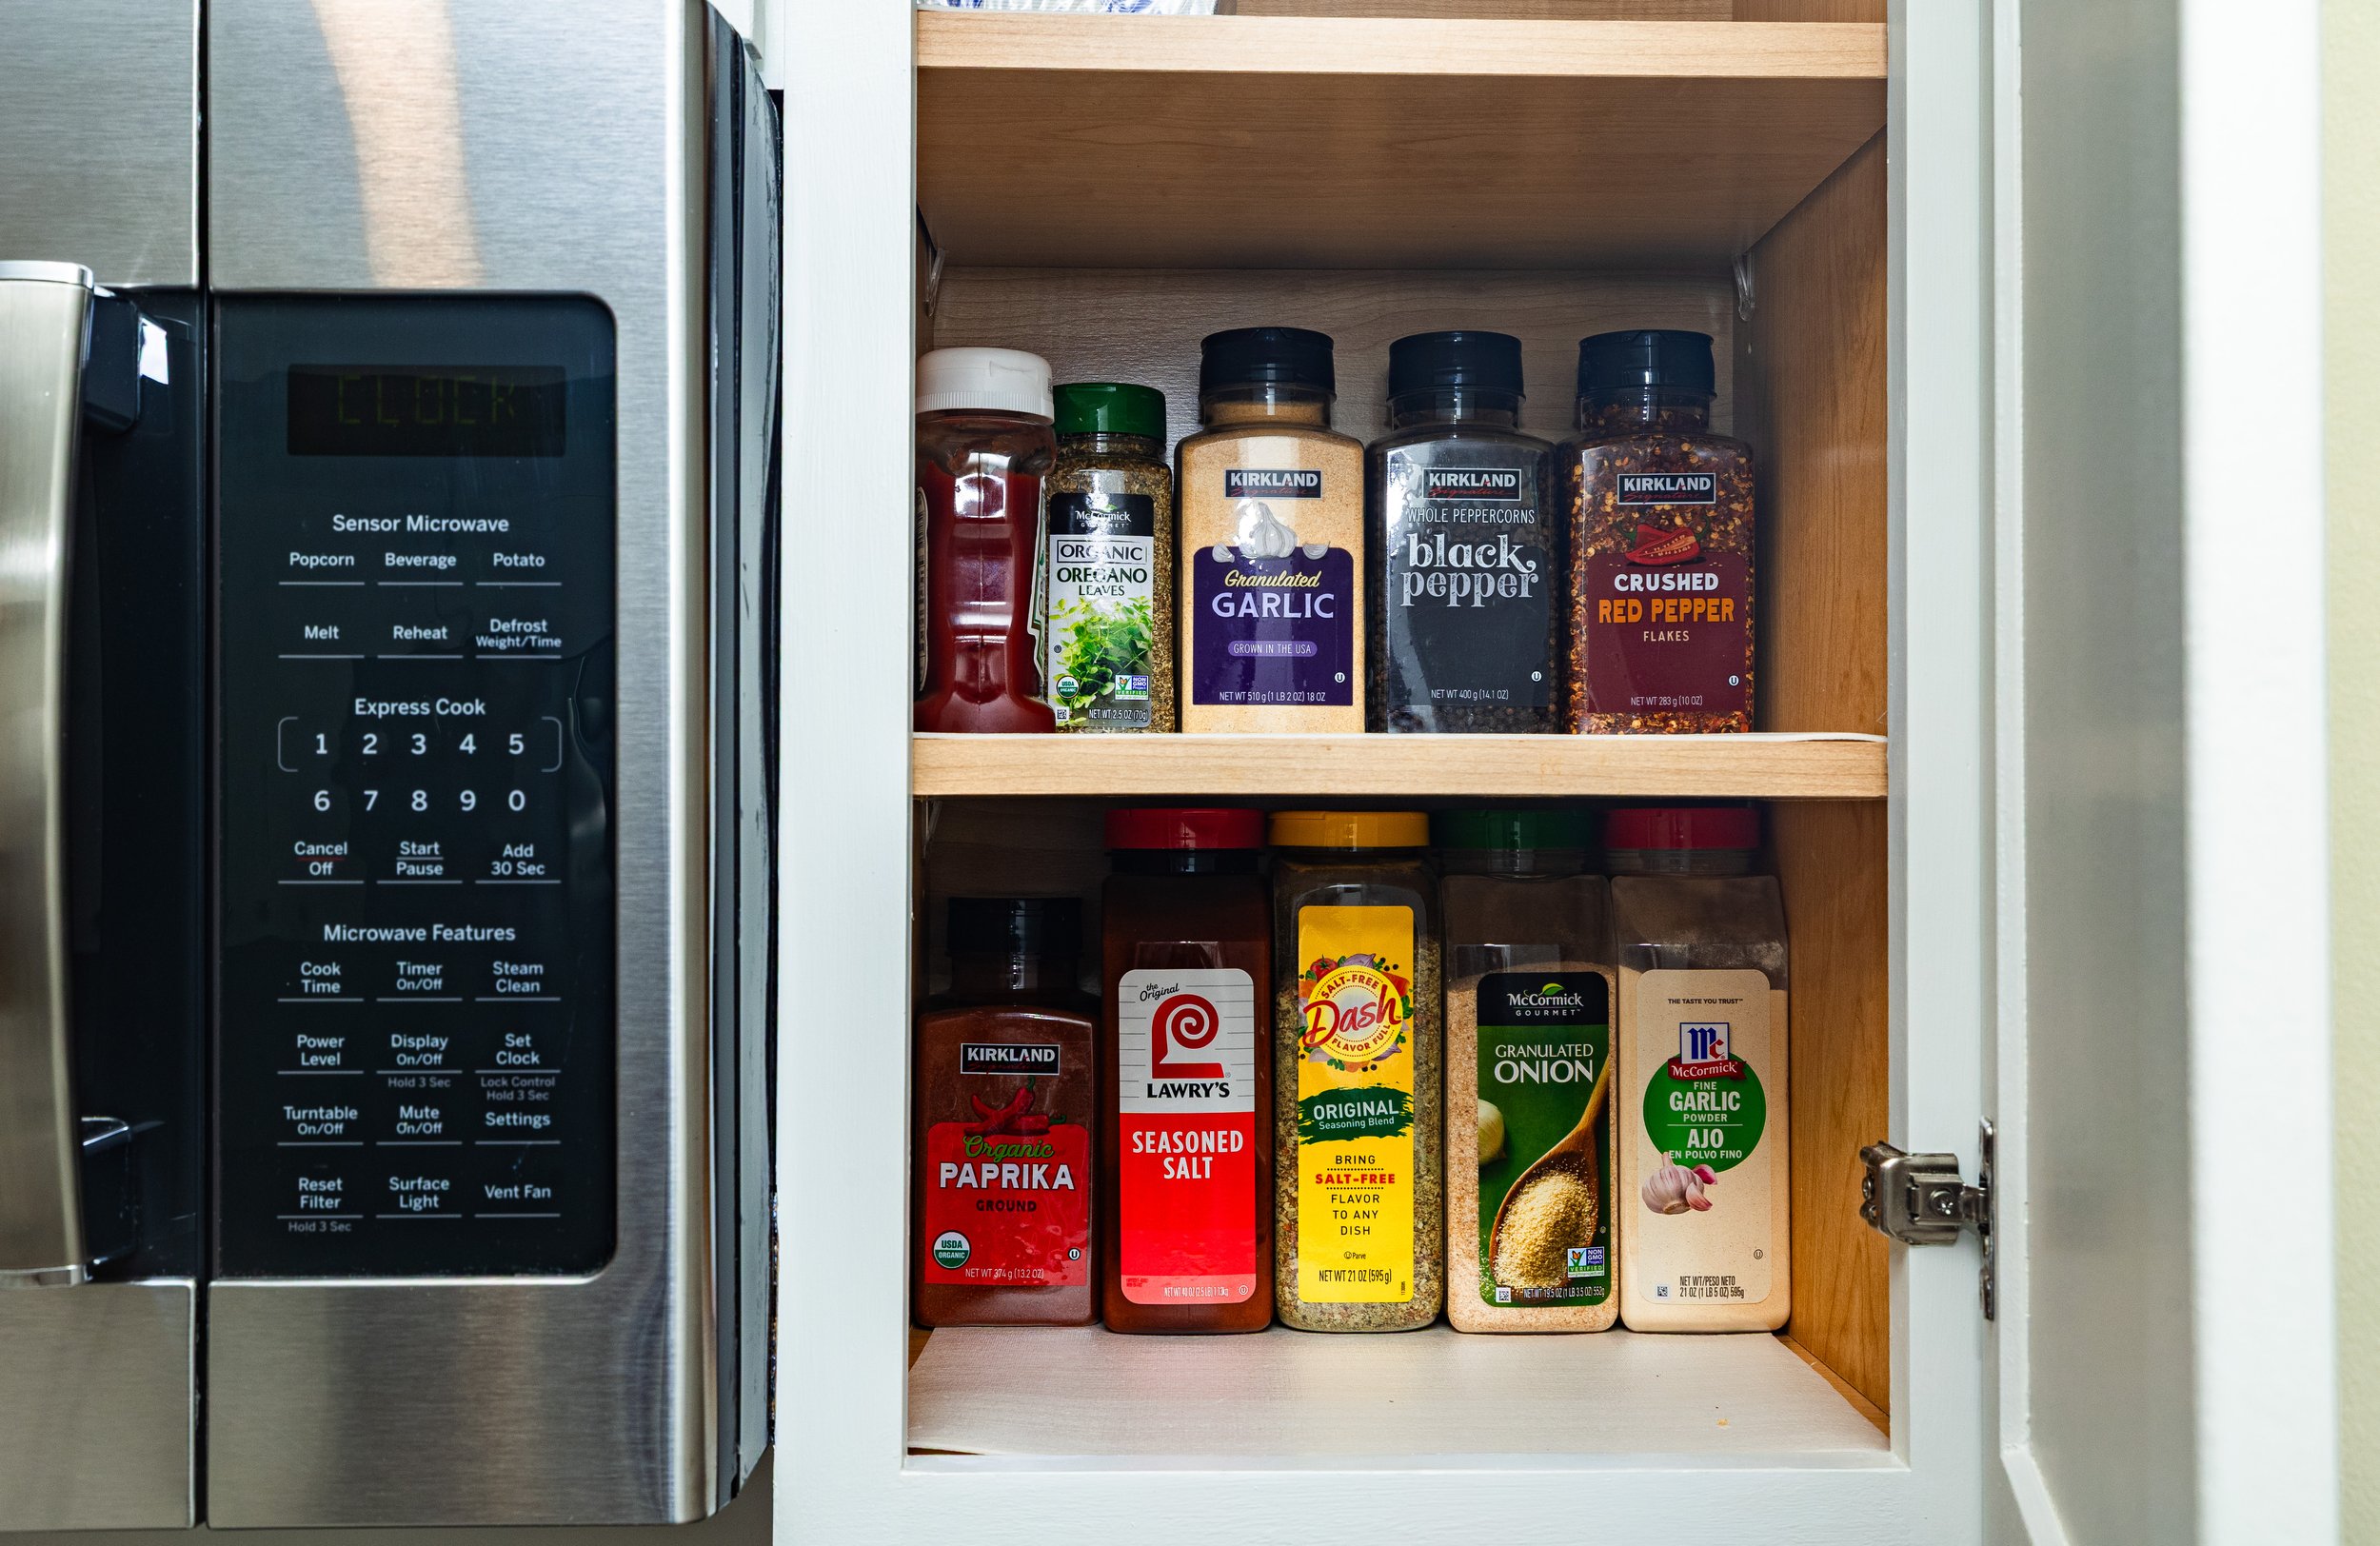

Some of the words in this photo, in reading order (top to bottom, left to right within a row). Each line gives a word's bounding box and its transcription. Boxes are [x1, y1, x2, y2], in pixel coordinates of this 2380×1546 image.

[1230, 472, 1319, 487] KIRKLAND
[1429, 472, 1517, 487] KIRKLAND
[1624, 477, 1712, 492] KIRKLAND
[332, 514, 401, 532] Sensor
[407, 514, 509, 532] Microwave
[1407, 507, 1448, 523] WHOLE
[1453, 507, 1535, 524] PEPPERCORNS
[289, 552, 354, 568] Popcorn
[493, 552, 545, 567] Potato
[1406, 533, 1537, 572] black
[385, 552, 457, 569] Beverage
[1057, 567, 1147, 584] OREGANO
[1224, 569, 1322, 588] Granulated
[1614, 573, 1719, 591] CRUSHED
[1079, 585, 1125, 596] LEAVES
[1399, 571, 1539, 607] pepper
[1212, 592, 1335, 619] GARLIC
[1598, 598, 1643, 624] RED
[1651, 598, 1735, 623] PEPPER
[305, 625, 339, 640] Melt
[393, 625, 448, 640] Reheat
[489, 618, 548, 633] Defrost
[476, 635, 562, 650] Weight/Time
[1643, 630, 1690, 642] FLAKES
[1233, 644, 1262, 654] GROWN
[1265, 644, 1274, 654] IN
[1277, 644, 1292, 654] THE
[1295, 644, 1312, 654] USA
[1431, 690, 1445, 700] NET
[1446, 690, 1458, 700] WT
[1459, 690, 1471, 700] 400
[1473, 692, 1478, 701] g
[1479, 689, 1495, 700] (14.1
[1497, 689, 1509, 700] OZ)
[1631, 696, 1644, 705] NET
[1646, 696, 1657, 705] WT
[1659, 696, 1672, 705] 283
[1673, 698, 1677, 707] g
[1678, 695, 1690, 705] (10
[1691, 695, 1703, 705] OZ)
[354, 698, 430, 719] Express
[435, 698, 486, 716] Cook
[315, 733, 327, 755] 1
[362, 733, 378, 755] 2
[410, 733, 426, 755] 3
[459, 733, 477, 755] 4
[508, 733, 525, 755] 5
[314, 790, 330, 811] 6
[364, 790, 379, 811] 7
[411, 790, 428, 811] 8
[459, 790, 476, 811] 9
[507, 790, 526, 811] 0
[294, 841, 347, 856] Cancel
[400, 842, 440, 856] Start
[503, 844, 533, 858] Add
[309, 862, 333, 876] Off
[396, 862, 444, 876] Pause
[490, 862, 512, 876] 30
[516, 862, 545, 876] Sec
[324, 924, 426, 941] Microwave
[432, 924, 516, 941] Features
[300, 961, 342, 977] Cook
[396, 961, 443, 976] Timer
[492, 961, 544, 976] Steam
[302, 980, 342, 994] Time
[396, 978, 443, 992] On/Off
[495, 979, 541, 993] Clean
[1140, 982, 1180, 1001] Original
[1146, 983, 1159, 992] the
[1321, 975, 1379, 999] SALT-FREE
[1507, 989, 1583, 1007] McCormick
[1302, 984, 1401, 1047] Dash
[297, 1034, 346, 1049] Power
[390, 1034, 449, 1051] Display
[505, 1033, 531, 1047] Set
[1332, 1039, 1371, 1052] FLAVOR
[1372, 1024, 1390, 1044] FULL
[496, 1050, 541, 1065] Clock
[967, 1047, 1056, 1061] KIRKLAND
[1495, 1043, 1594, 1059] GRANULATED
[301, 1052, 341, 1066] Level
[396, 1053, 443, 1066] On/Off
[1494, 1060, 1594, 1083] ONION
[1672, 1061, 1736, 1078] McCormick
[387, 1077, 416, 1088] Hold
[419, 1077, 426, 1088] 3
[428, 1077, 451, 1088] Sec
[481, 1076, 508, 1088] Lock
[510, 1076, 556, 1088] Control
[1694, 1081, 1716, 1090] FINE
[486, 1090, 514, 1101] Hold
[517, 1090, 526, 1101] 3
[527, 1090, 549, 1101] Sec
[1146, 1082, 1230, 1099] LAWRY'S
[1669, 1091, 1740, 1112] GARLIC
[283, 1106, 358, 1120] Turntable
[399, 1105, 440, 1120] Mute
[1313, 1100, 1398, 1120] ORIGINAL
[1683, 1113, 1727, 1122] POWDER
[485, 1112, 551, 1129] Settings
[1319, 1120, 1366, 1131] Seasoning
[1368, 1117, 1395, 1126] Blend
[297, 1122, 344, 1135] On/Off
[396, 1122, 443, 1135] On/Off
[1132, 1131, 1243, 1154] SEASONED
[1687, 1128, 1724, 1149] AJO
[962, 1135, 1055, 1162] Organic
[1668, 1150, 1682, 1160] EN
[1685, 1150, 1716, 1160] POLVO
[1719, 1149, 1742, 1159] FINO
[1336, 1155, 1376, 1164] BRING
[940, 1162, 1075, 1190] PAPRIKA
[1163, 1158, 1214, 1179] SALT
[298, 1178, 343, 1192] Reset
[388, 1177, 450, 1191] Surface
[1315, 1173, 1396, 1184] SALT-FREE
[485, 1185, 520, 1199] Vent
[524, 1185, 551, 1199] Fan
[1331, 1194, 1380, 1203] FLAVOR
[300, 1195, 341, 1209] Filter
[399, 1195, 439, 1211] Light
[976, 1199, 1038, 1212] GROUND
[1333, 1210, 1349, 1219] TO
[1353, 1210, 1378, 1219] ANY
[288, 1221, 316, 1232] Hold
[319, 1221, 327, 1232] 3
[329, 1221, 351, 1232] Sec
[1340, 1226, 1371, 1235] DISH
[942, 1239, 962, 1250] USDA
[938, 1250, 965, 1259] ORGANIC
[1352, 1252, 1366, 1260] Parve
[1319, 1270, 1333, 1282] NET
[1334, 1270, 1346, 1282] WT
[1347, 1270, 1357, 1282] 21
[1358, 1270, 1367, 1282] OZ
[1679, 1276, 1691, 1286] NET
[1692, 1276, 1720, 1286] WT/PESO
[1721, 1276, 1735, 1286] NETO
